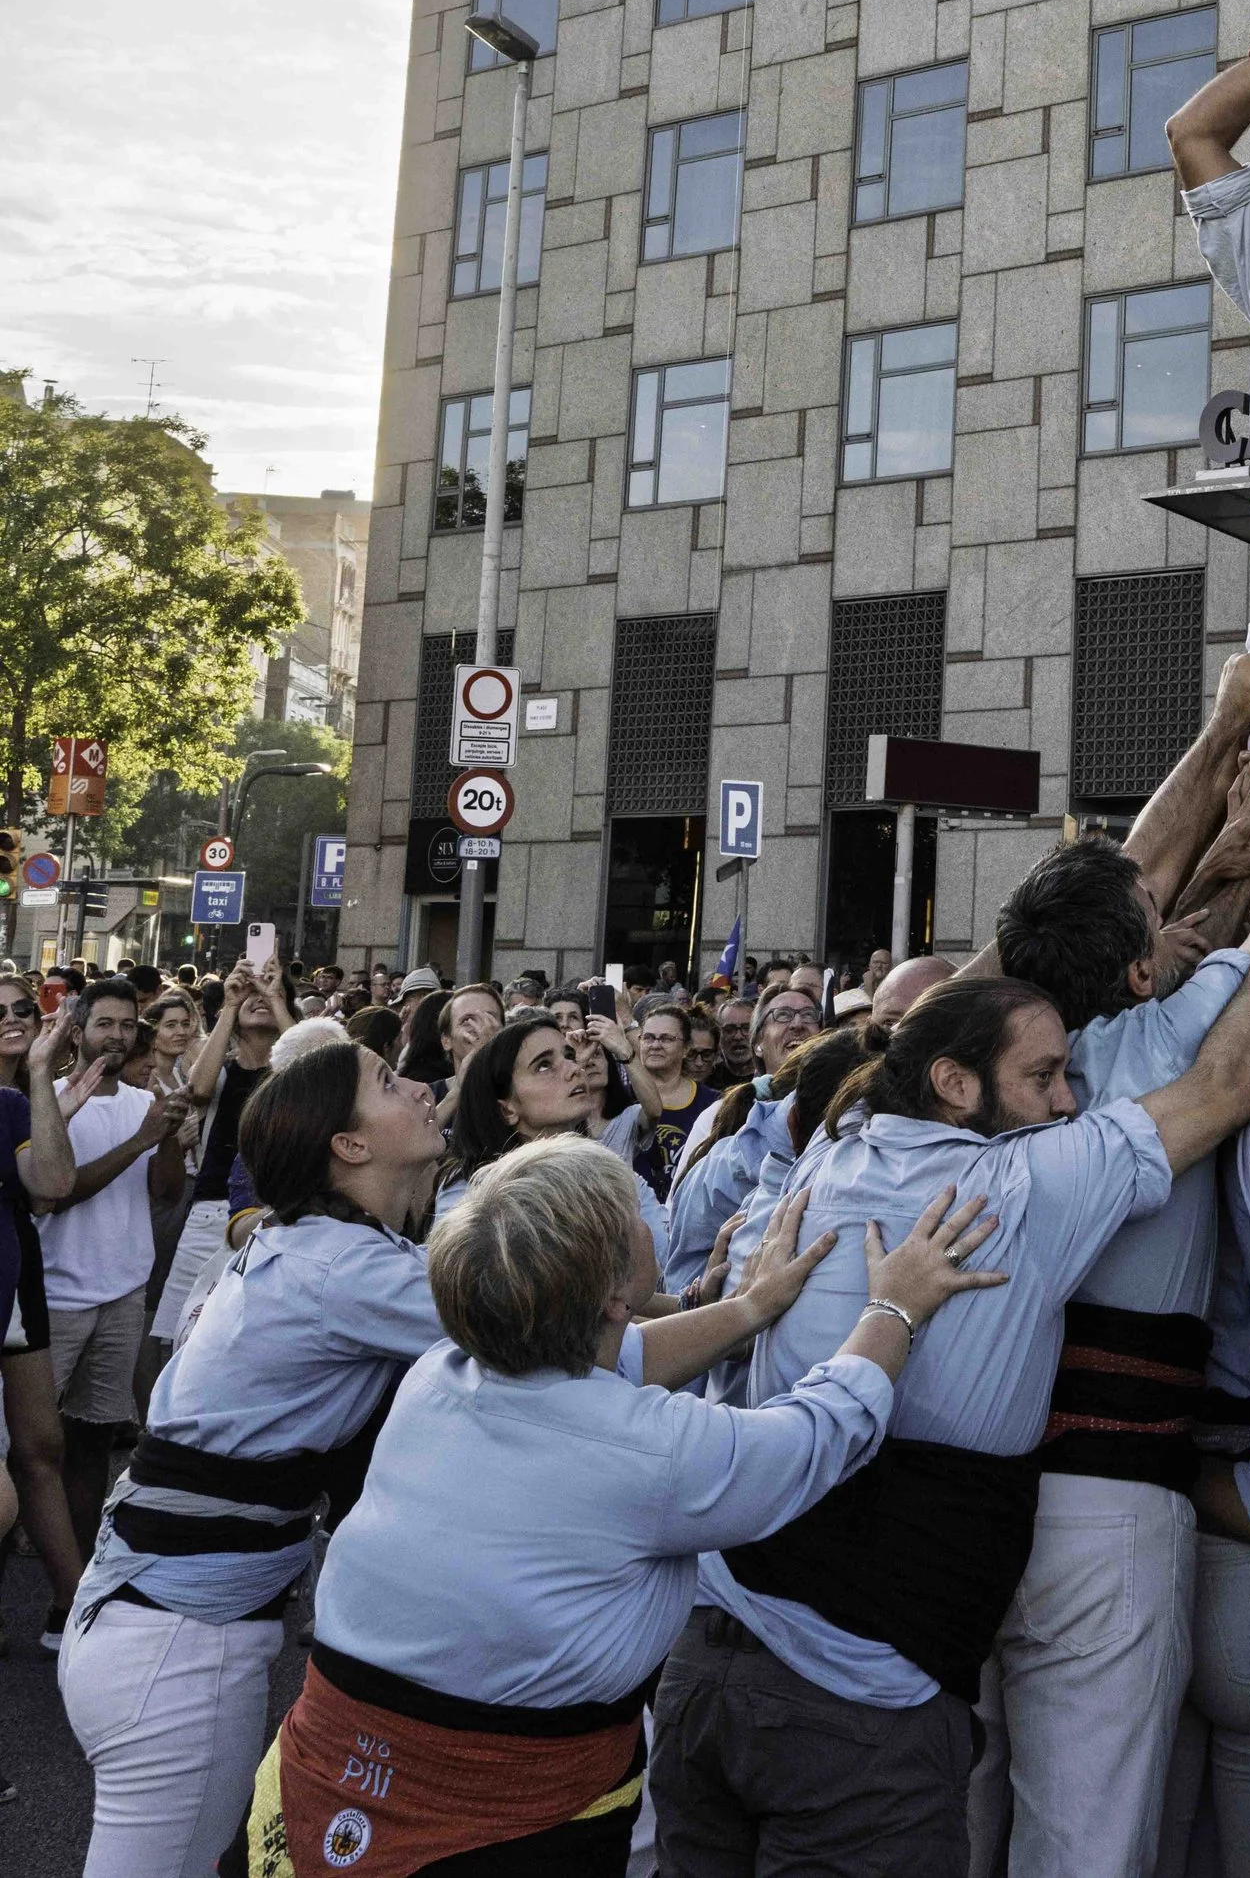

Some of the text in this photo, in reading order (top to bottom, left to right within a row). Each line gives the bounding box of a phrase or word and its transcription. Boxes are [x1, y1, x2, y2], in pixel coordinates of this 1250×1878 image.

[88, 748, 100, 762] M
[727, 790, 752, 847] P
[208, 848, 227, 859] 30
[208, 896, 228, 906] taxi
[338, 1754, 394, 1799] Pili
